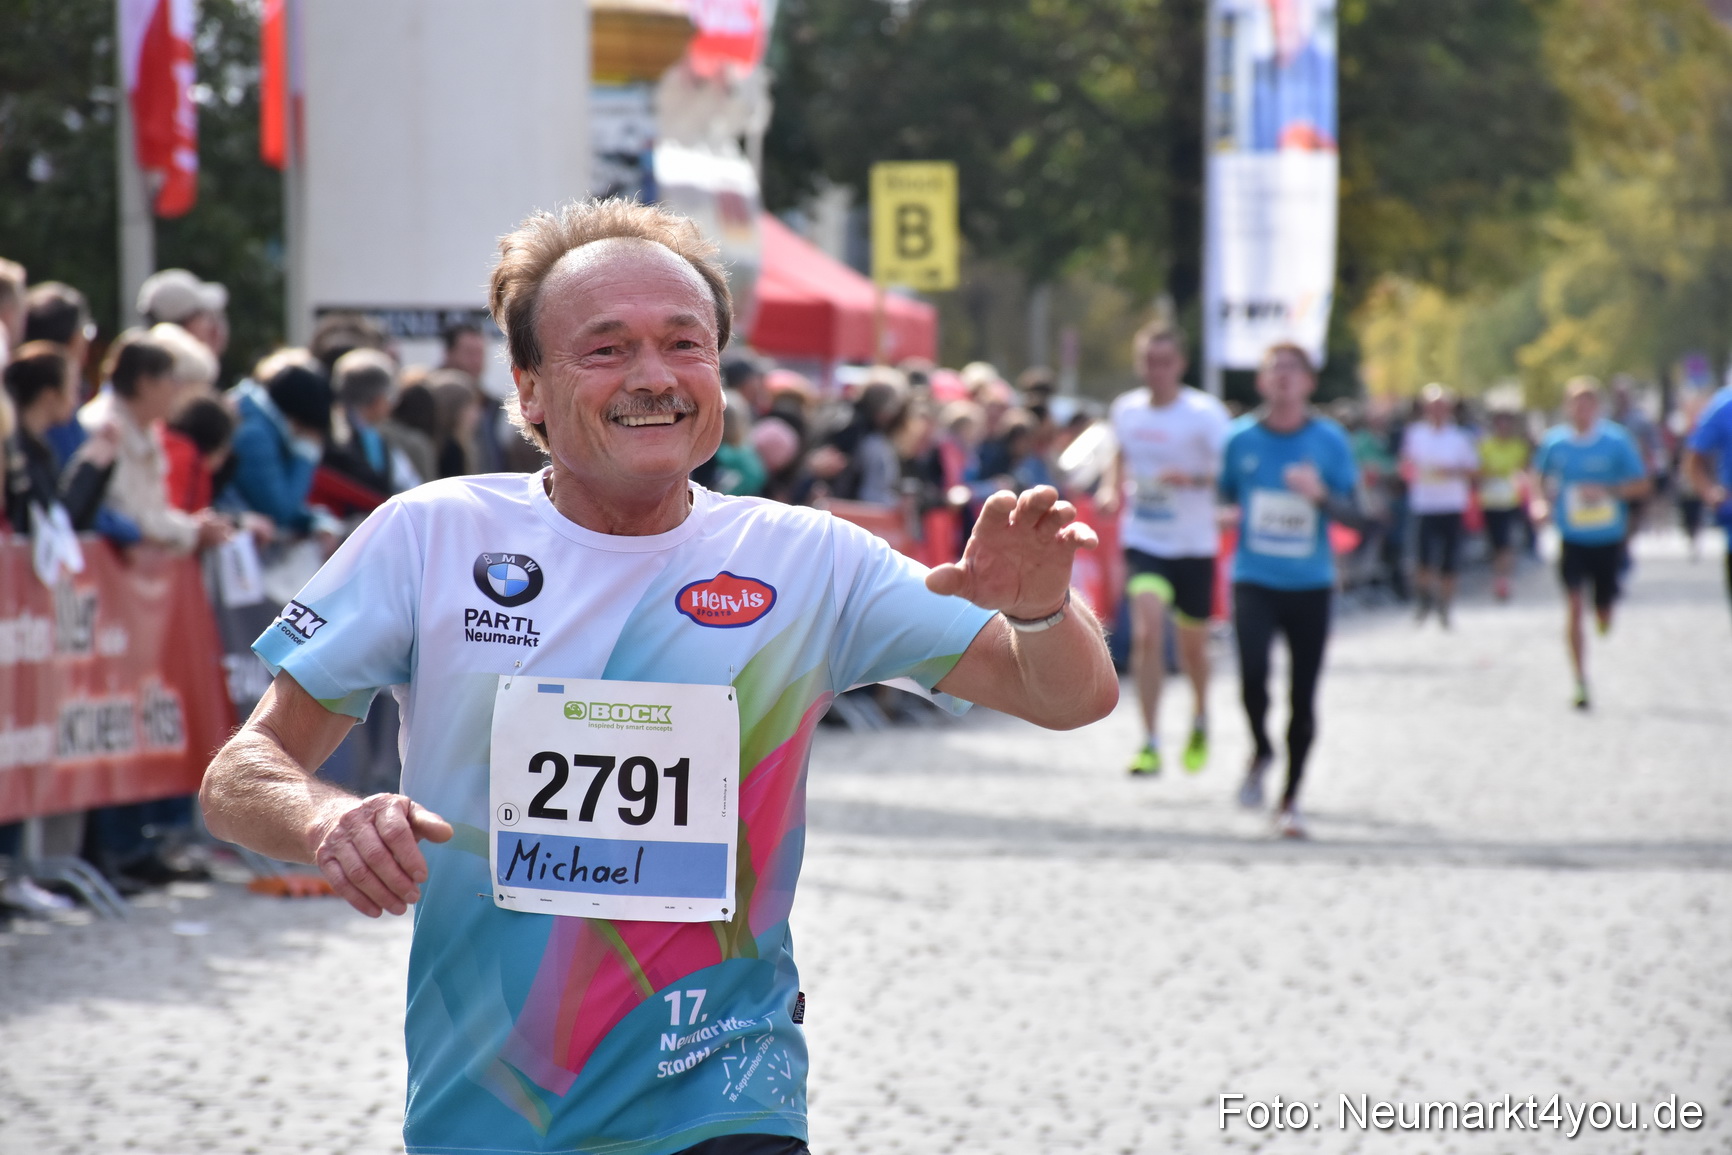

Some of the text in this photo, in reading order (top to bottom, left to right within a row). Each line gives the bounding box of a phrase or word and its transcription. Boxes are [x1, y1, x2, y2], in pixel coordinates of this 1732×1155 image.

[896, 204, 934, 260] B
[482, 554, 539, 573] BMW
[691, 589, 764, 612] Hervis
[696, 609, 732, 617] SPORTS
[281, 600, 328, 639] CK
[465, 608, 540, 635] PARTL
[465, 628, 540, 647] Neumarkt
[589, 702, 672, 724] BOCK
[528, 751, 690, 826] 2791
[504, 808, 513, 821] D
[505, 839, 644, 884] Michael
[664, 989, 708, 1026] 17.
[729, 1036, 775, 1103] 18. September 2016
